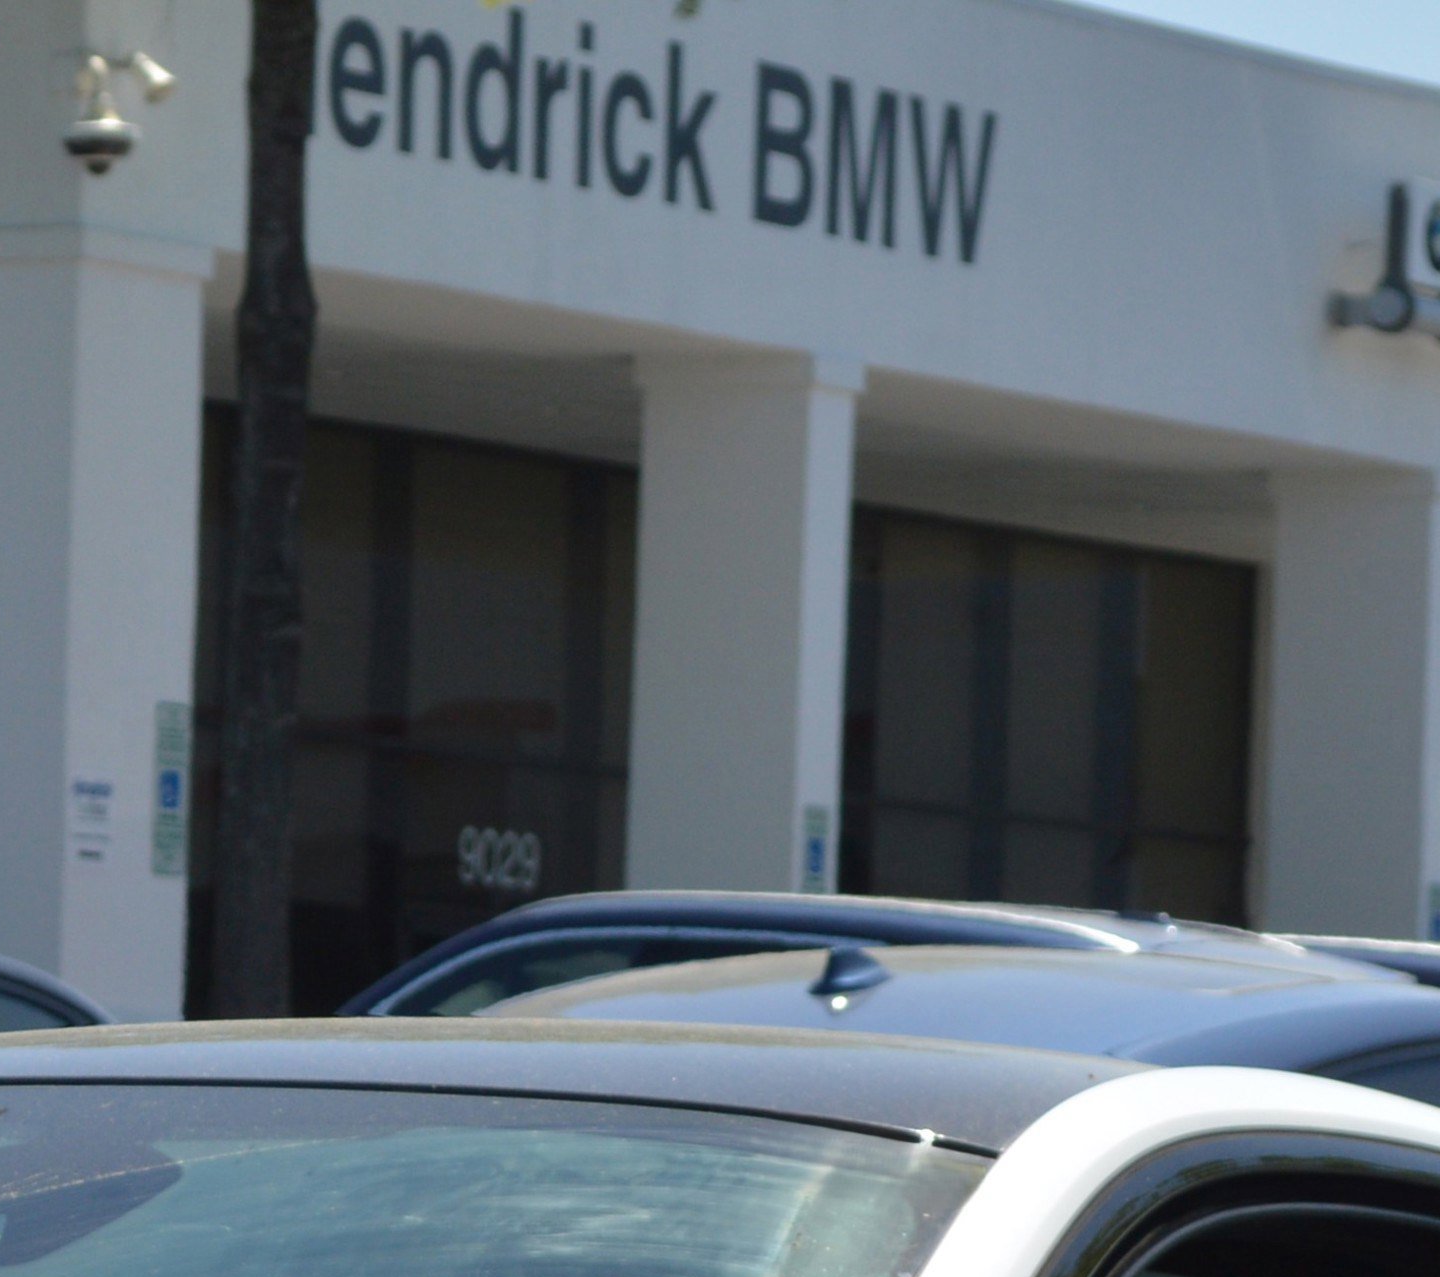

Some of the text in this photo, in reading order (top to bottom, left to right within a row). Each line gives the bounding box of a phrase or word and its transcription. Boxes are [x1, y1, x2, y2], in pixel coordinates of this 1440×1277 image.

[310, 6, 997, 265] endrick BMW
[456, 824, 543, 892] 9029
